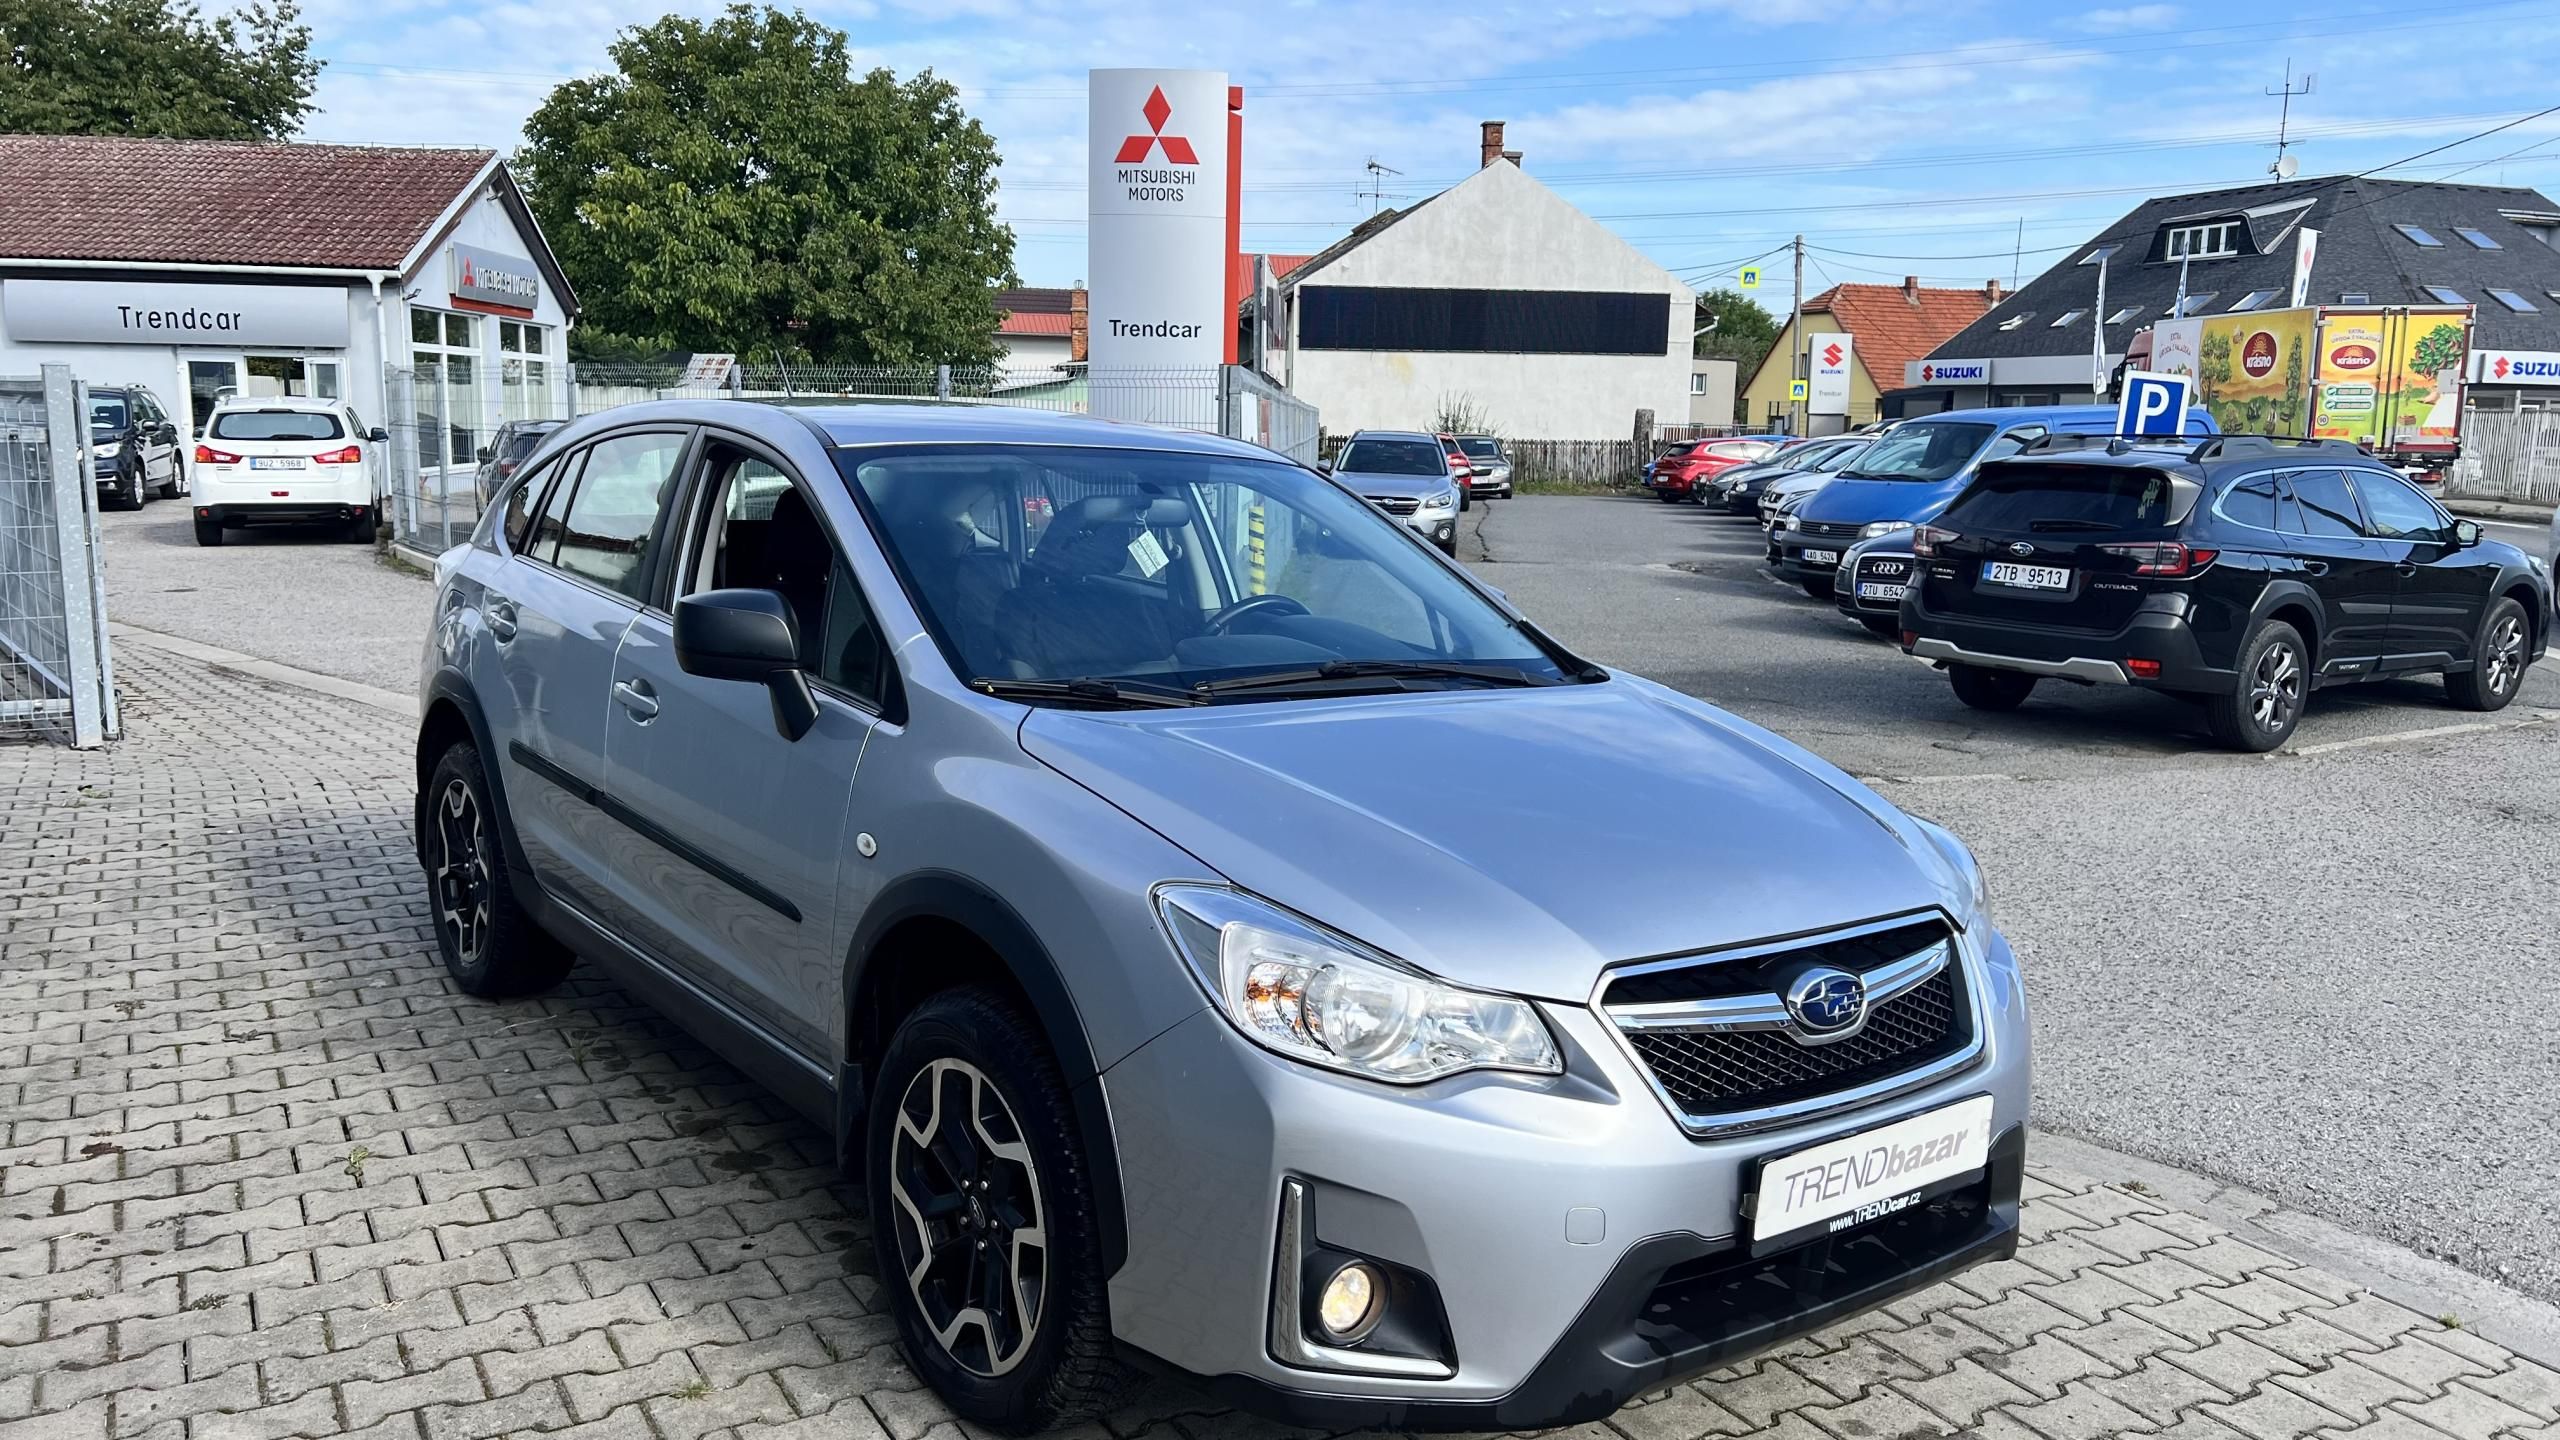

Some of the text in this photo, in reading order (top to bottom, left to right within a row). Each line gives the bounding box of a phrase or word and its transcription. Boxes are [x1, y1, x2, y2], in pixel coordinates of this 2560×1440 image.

[1118, 169, 1195, 185] MITSUBISHI
[1128, 187, 1184, 202] MOTORS
[117, 305, 241, 331] Trendcar
[1108, 319, 1202, 338] Trendcar
[1935, 365, 1984, 379] SUZUKI
[2512, 361, 2560, 377] SUZU
[2135, 382, 2170, 435] P
[257, 459, 302, 468] 9U2 5968
[1993, 564, 2018, 581] 2TB
[2027, 568, 2063, 586] 9513
[1863, 584, 1905, 598] 2TU 6542
[2094, 583, 2138, 591] OUTBACK
[1784, 1129, 1969, 1213] TRENDbazar
[1829, 1191, 1922, 1233] www.TRENDcar.cz
